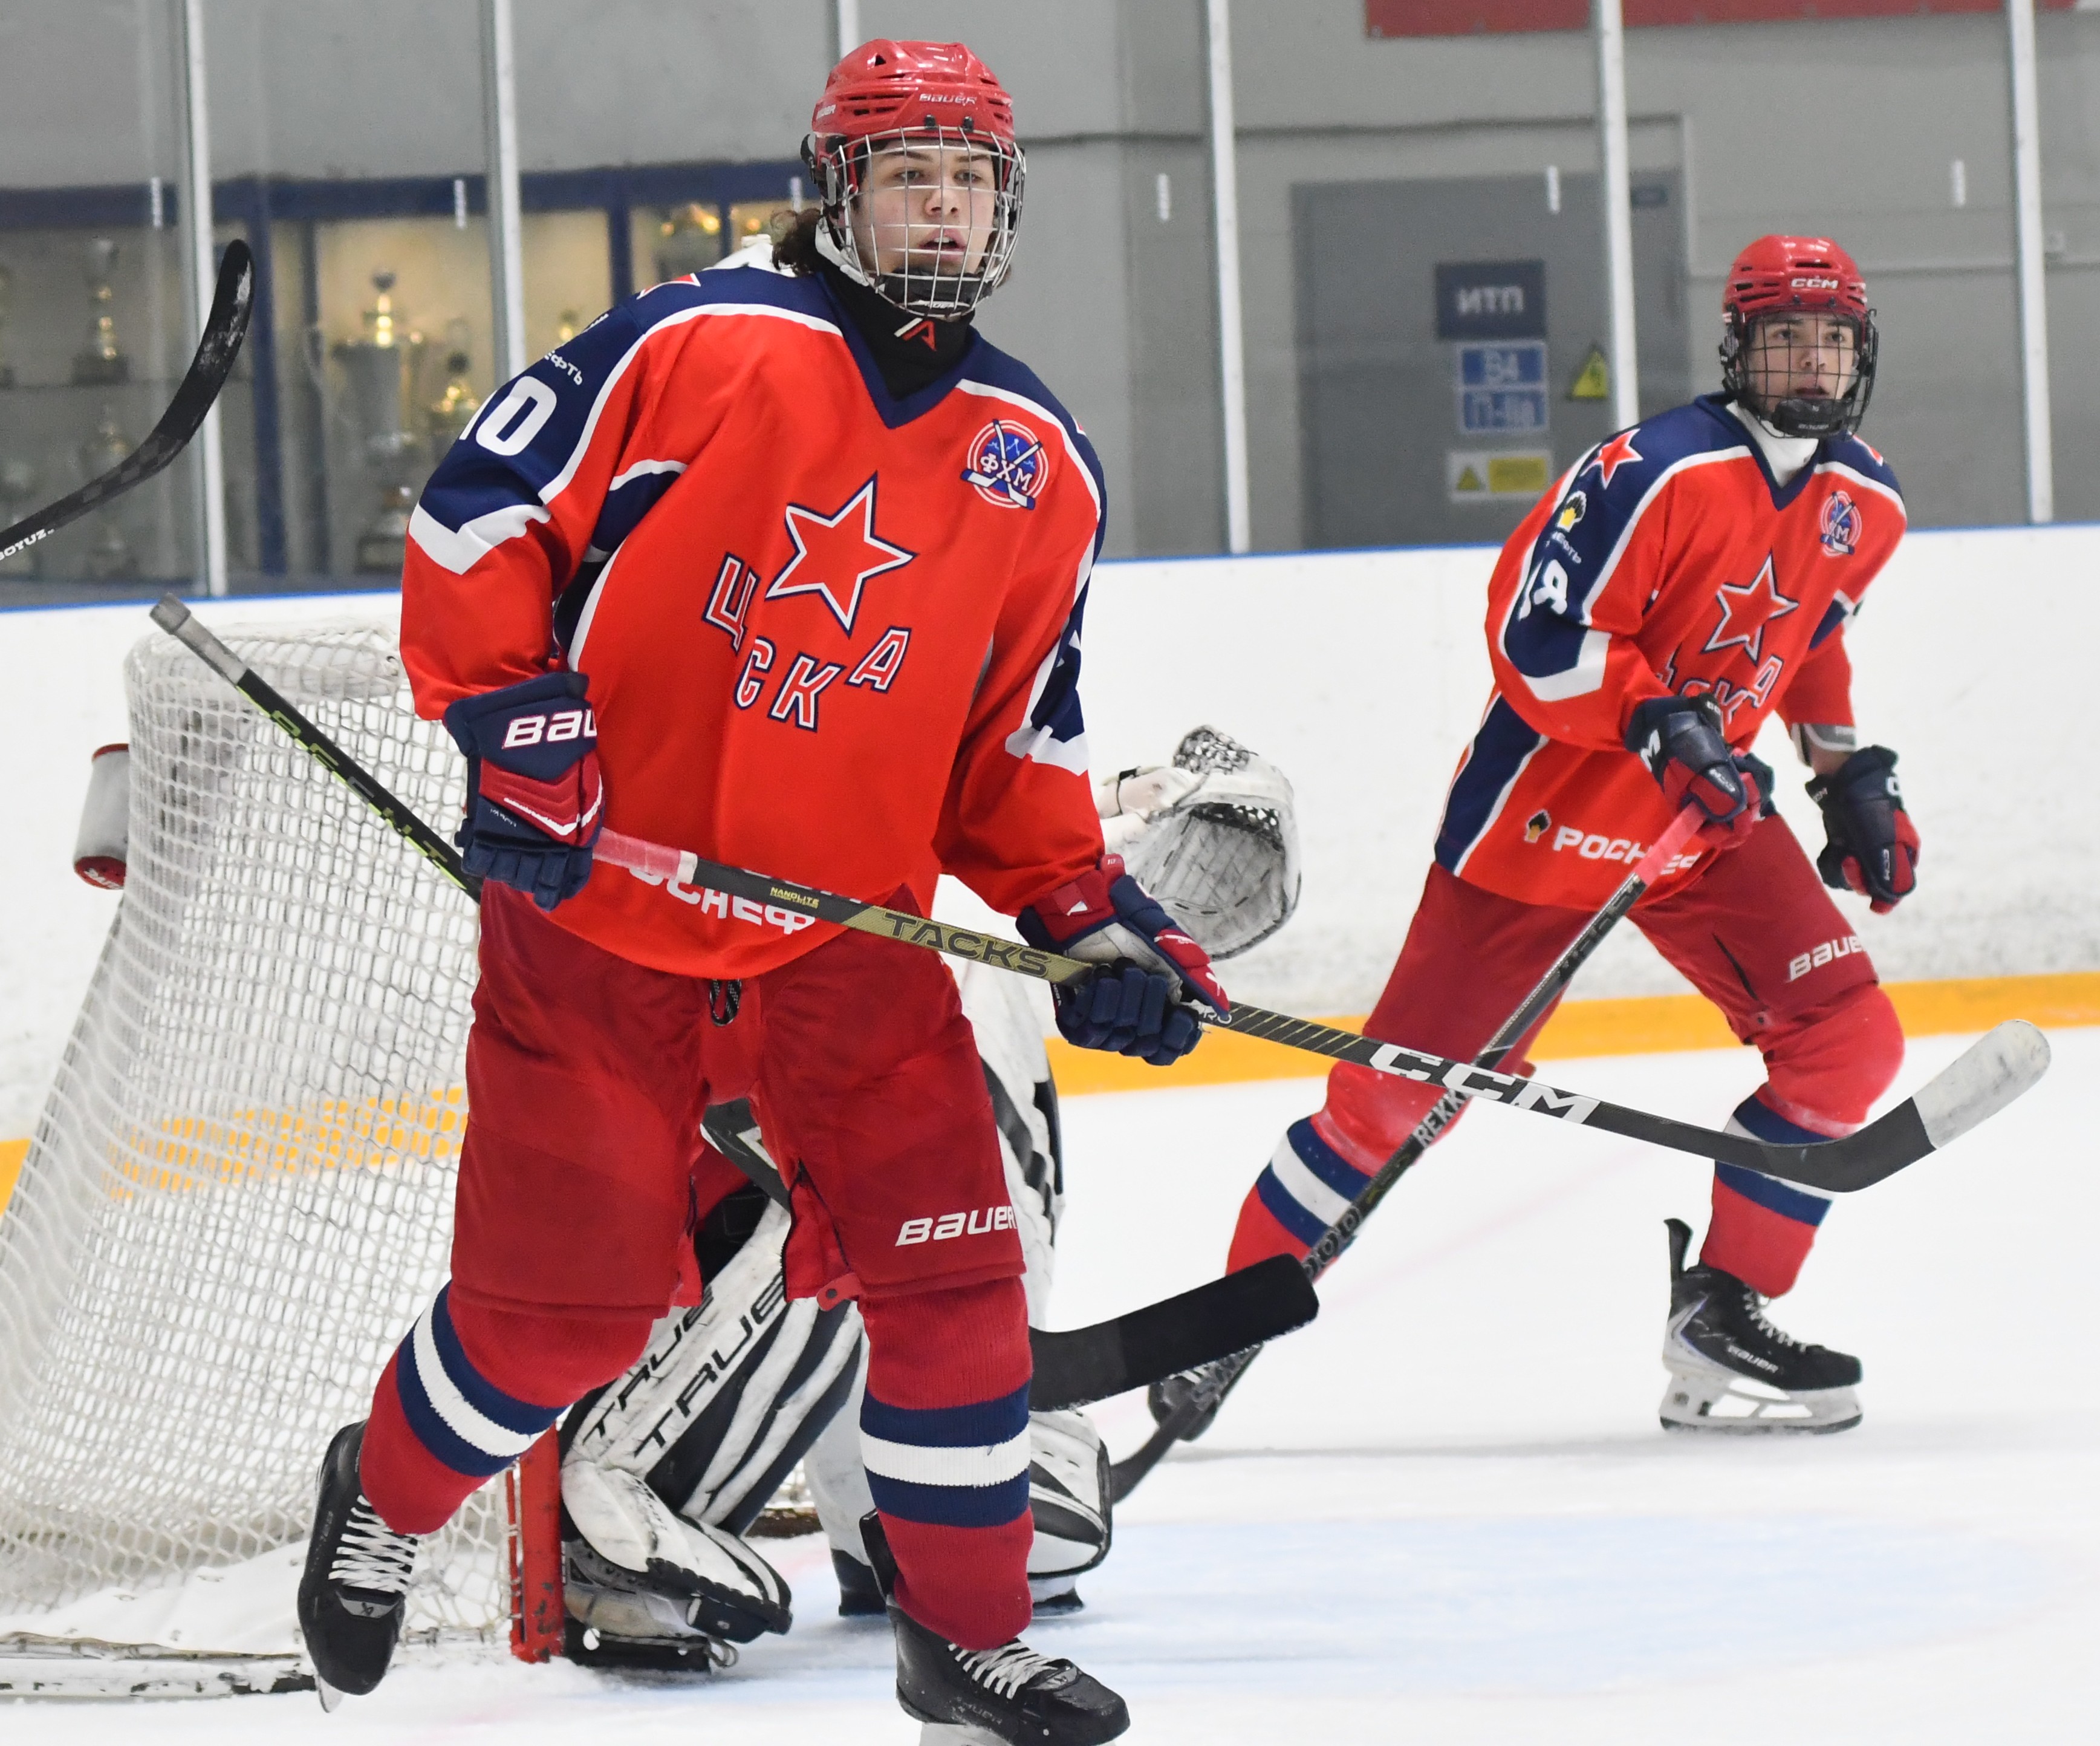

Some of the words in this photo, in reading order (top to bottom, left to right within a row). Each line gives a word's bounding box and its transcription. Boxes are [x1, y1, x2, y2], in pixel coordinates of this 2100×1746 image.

[1790, 278, 1839, 289] CCM
[980, 452, 1033, 491] ФХМ
[702, 552, 911, 732] ЦСКА
[877, 911, 1051, 977] TACKS
[1369, 1043, 1601, 1124] CCM
[633, 1271, 785, 1458] TRUE
